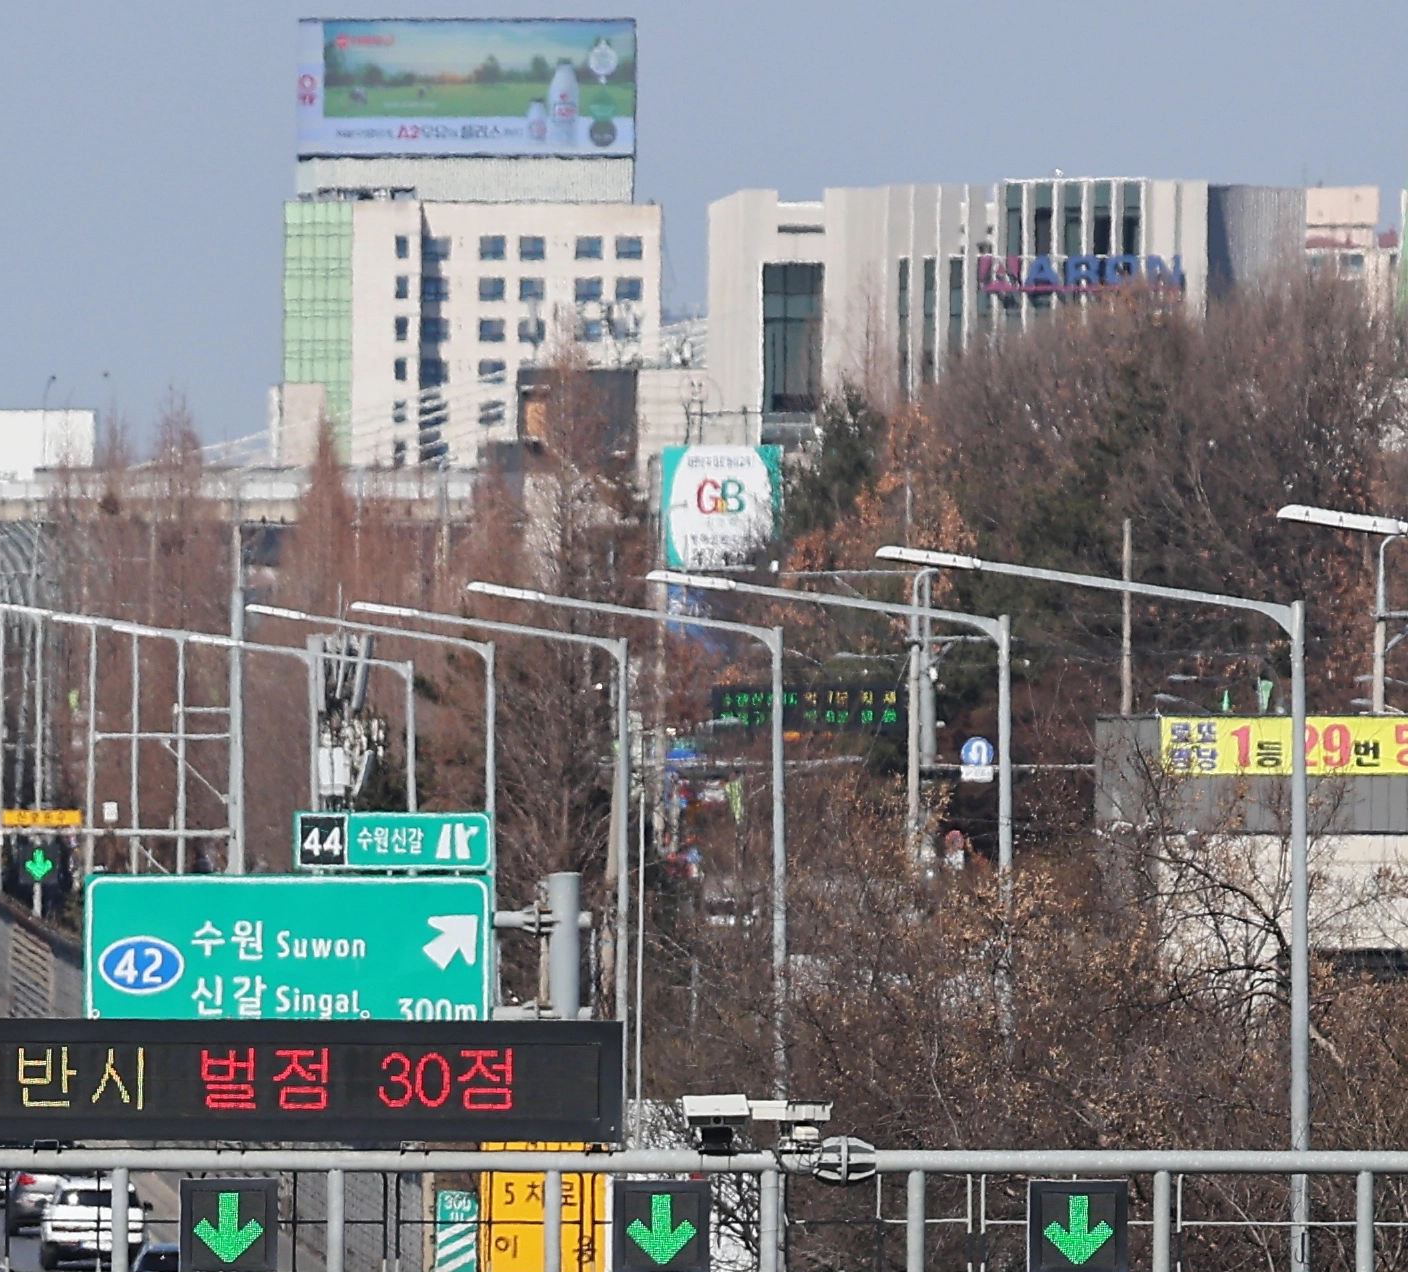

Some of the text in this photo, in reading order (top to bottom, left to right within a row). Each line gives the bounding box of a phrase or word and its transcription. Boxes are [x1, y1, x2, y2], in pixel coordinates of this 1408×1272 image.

[303, 826, 343, 857] 44
[357, 826, 425, 855] 수원신갈
[191, 919, 366, 961] 수원 Suwon
[112, 947, 163, 984] 42
[190, 975, 359, 1018] 신갈 Singal
[398, 997, 477, 1021] 300m
[200, 1046, 330, 1111] 벌점
[377, 1046, 515, 1111] 30점
